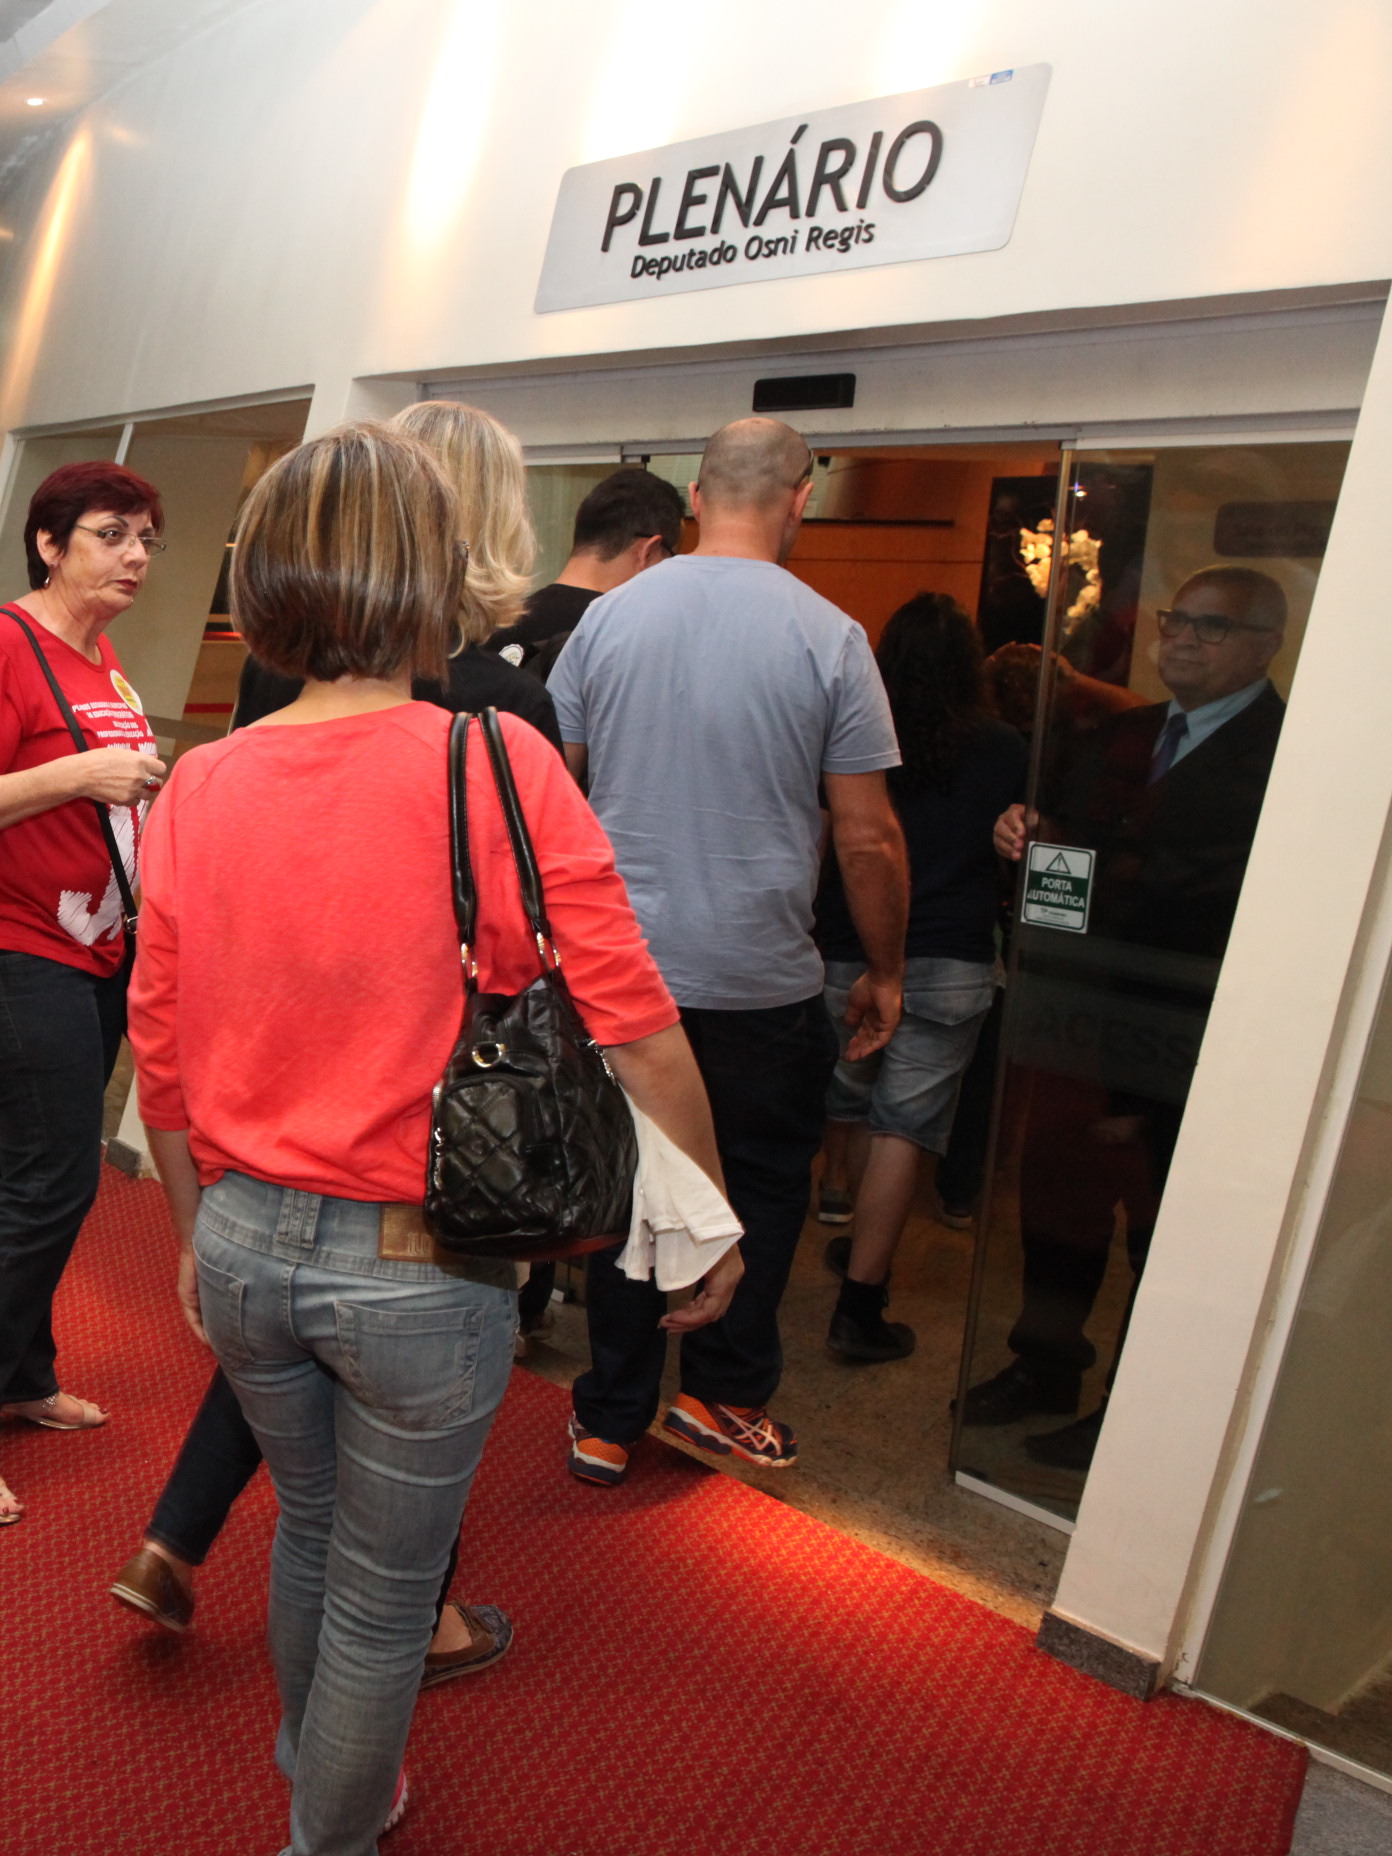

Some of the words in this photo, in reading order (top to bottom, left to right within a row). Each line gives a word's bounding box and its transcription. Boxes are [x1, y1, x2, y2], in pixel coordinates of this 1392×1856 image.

[601, 120, 943, 252] PLENÁRIO
[630, 240, 737, 280] Deputado
[744, 229, 798, 260] Osni
[805, 218, 876, 253] Regis
[1027, 889, 1085, 908] AUTOMÁTICA
[1041, 877, 1072, 892] PORTA
